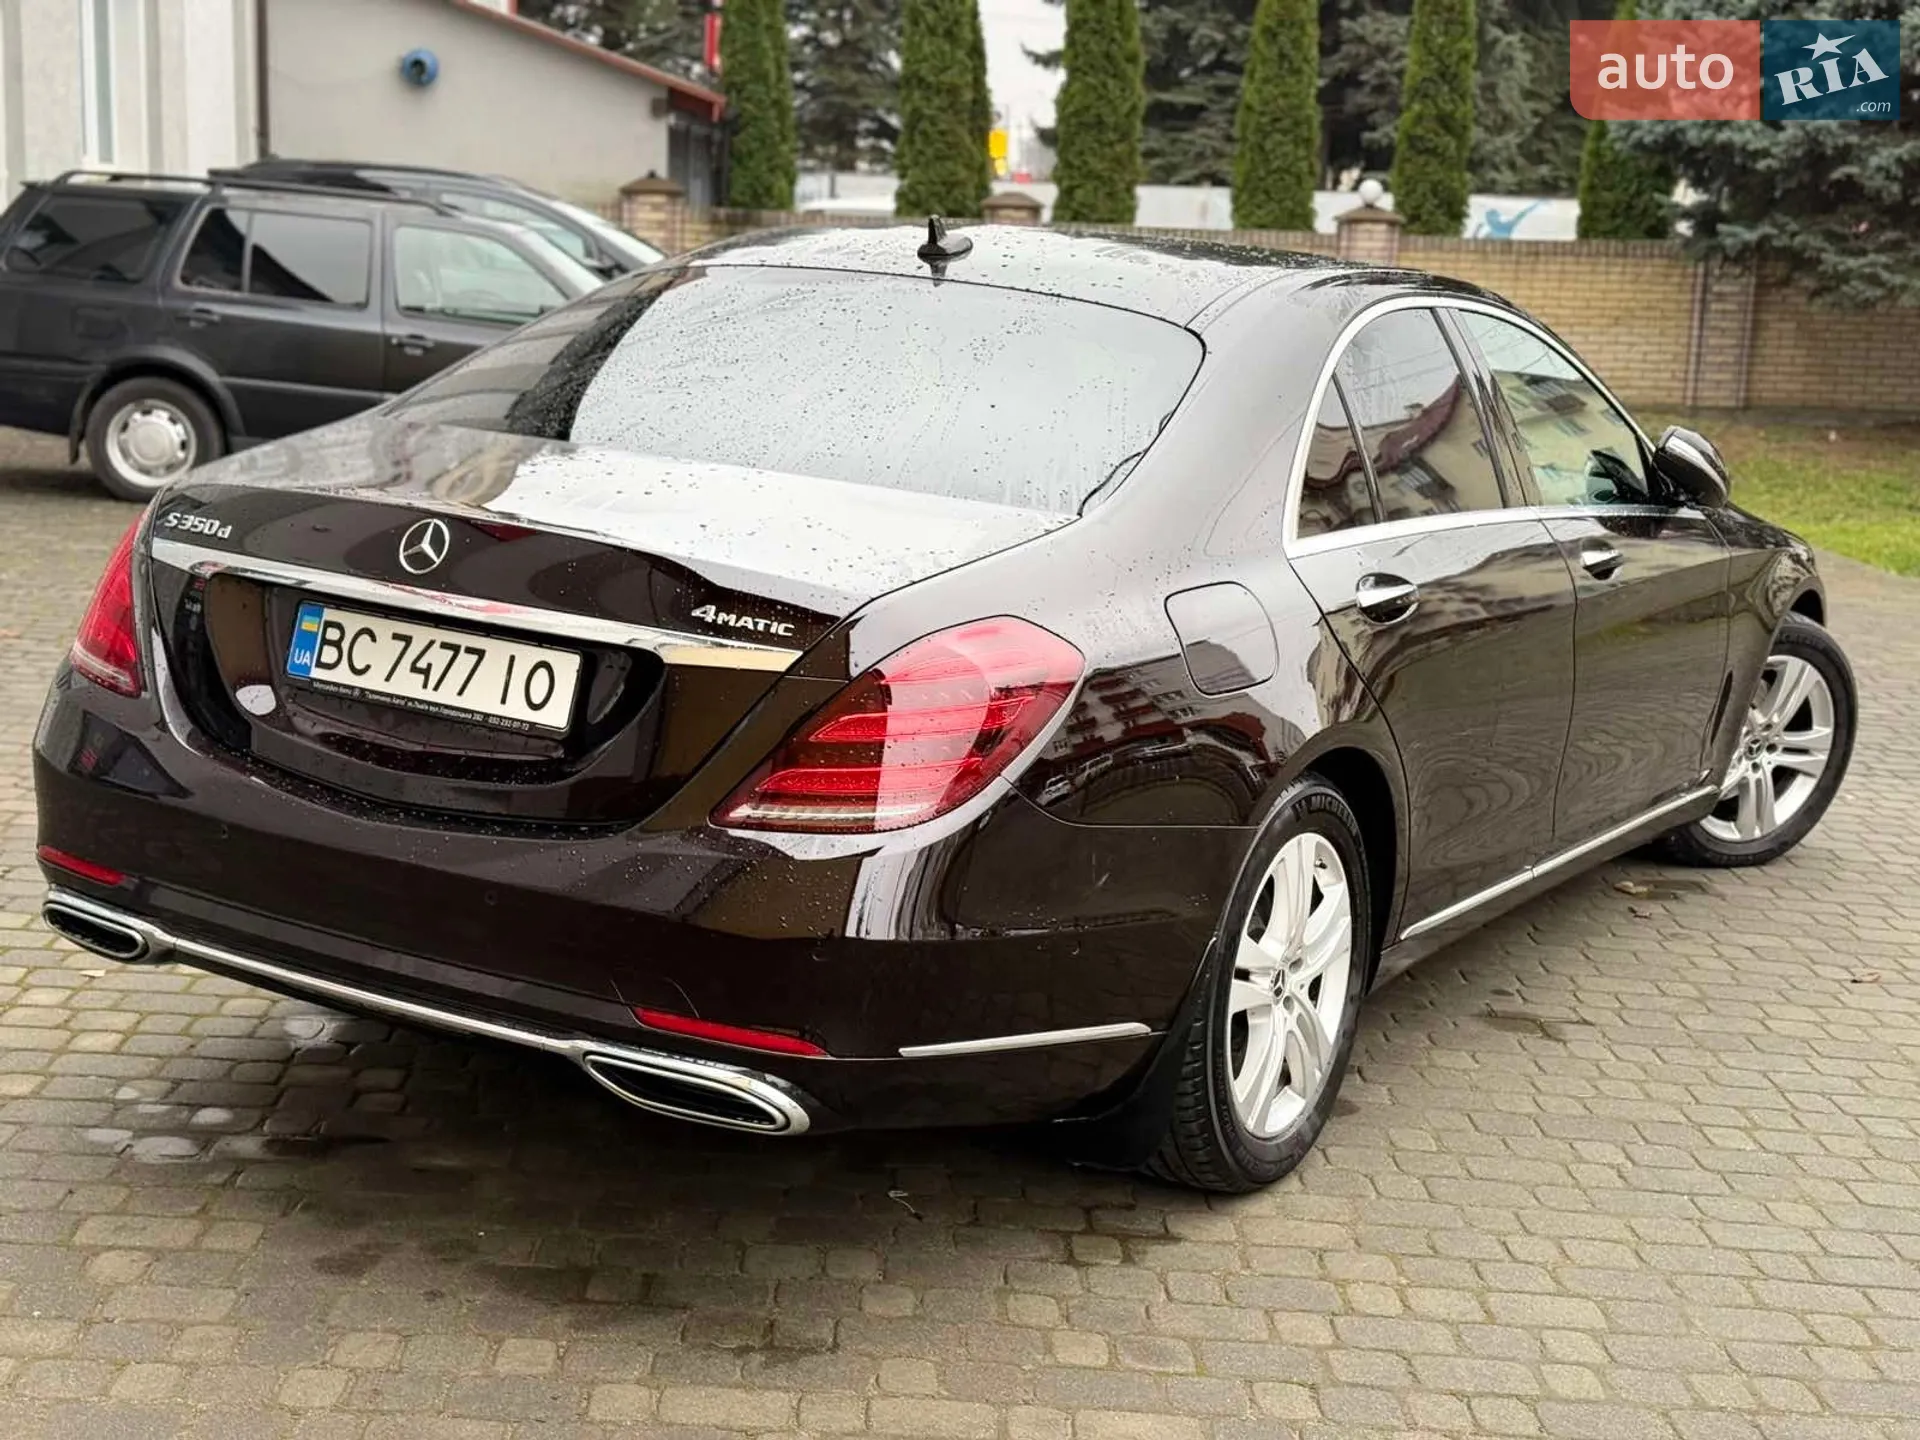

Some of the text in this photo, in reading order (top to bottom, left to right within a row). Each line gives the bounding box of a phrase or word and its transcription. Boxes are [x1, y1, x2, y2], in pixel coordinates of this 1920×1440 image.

[691, 604, 795, 636] 4MATIC
[294, 648, 311, 667] UA
[315, 620, 377, 677] BC
[384, 632, 487, 697] 7477
